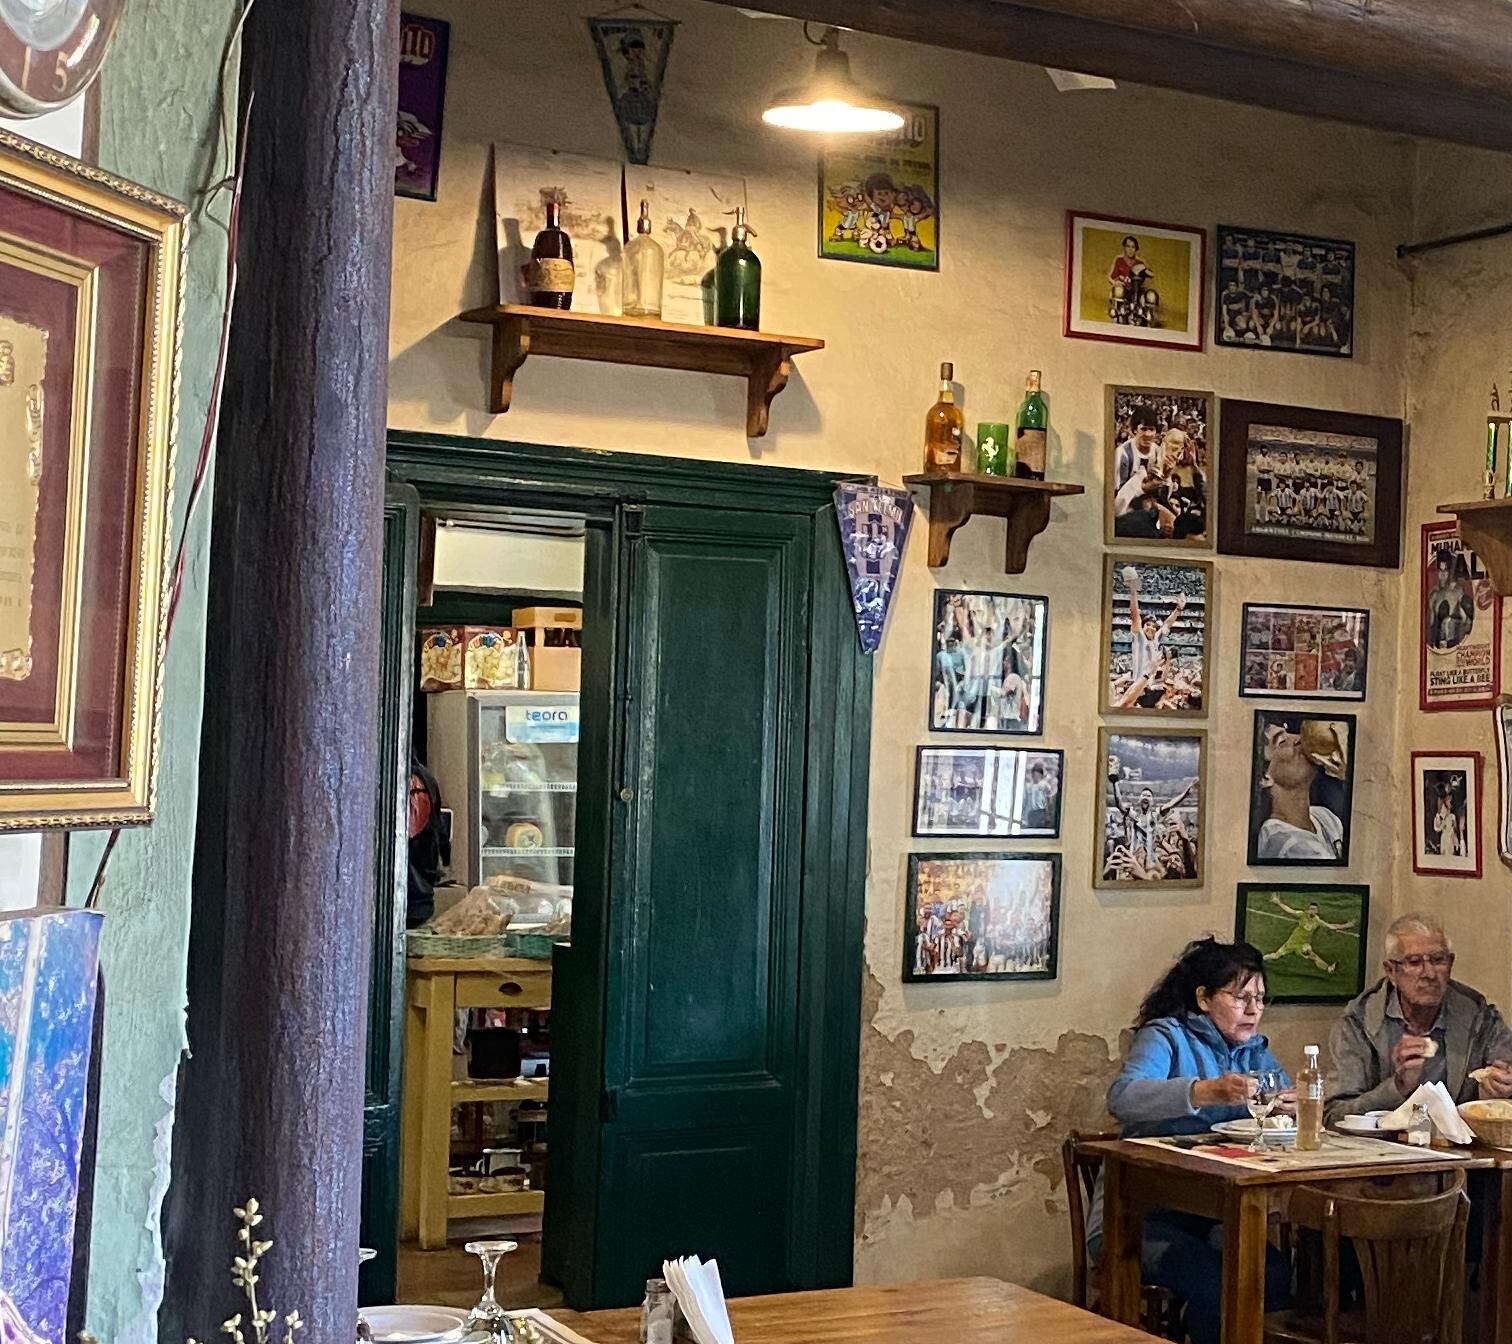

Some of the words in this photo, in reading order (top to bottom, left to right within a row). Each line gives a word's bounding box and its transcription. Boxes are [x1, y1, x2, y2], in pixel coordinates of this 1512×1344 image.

[52, 50, 68, 93] 5
[1430, 676, 1451, 687] STING
[1452, 675, 1468, 685] LIKE
[1470, 675, 1476, 684] A
[1477, 673, 1491, 684] BEE
[525, 709, 568, 722] teora
